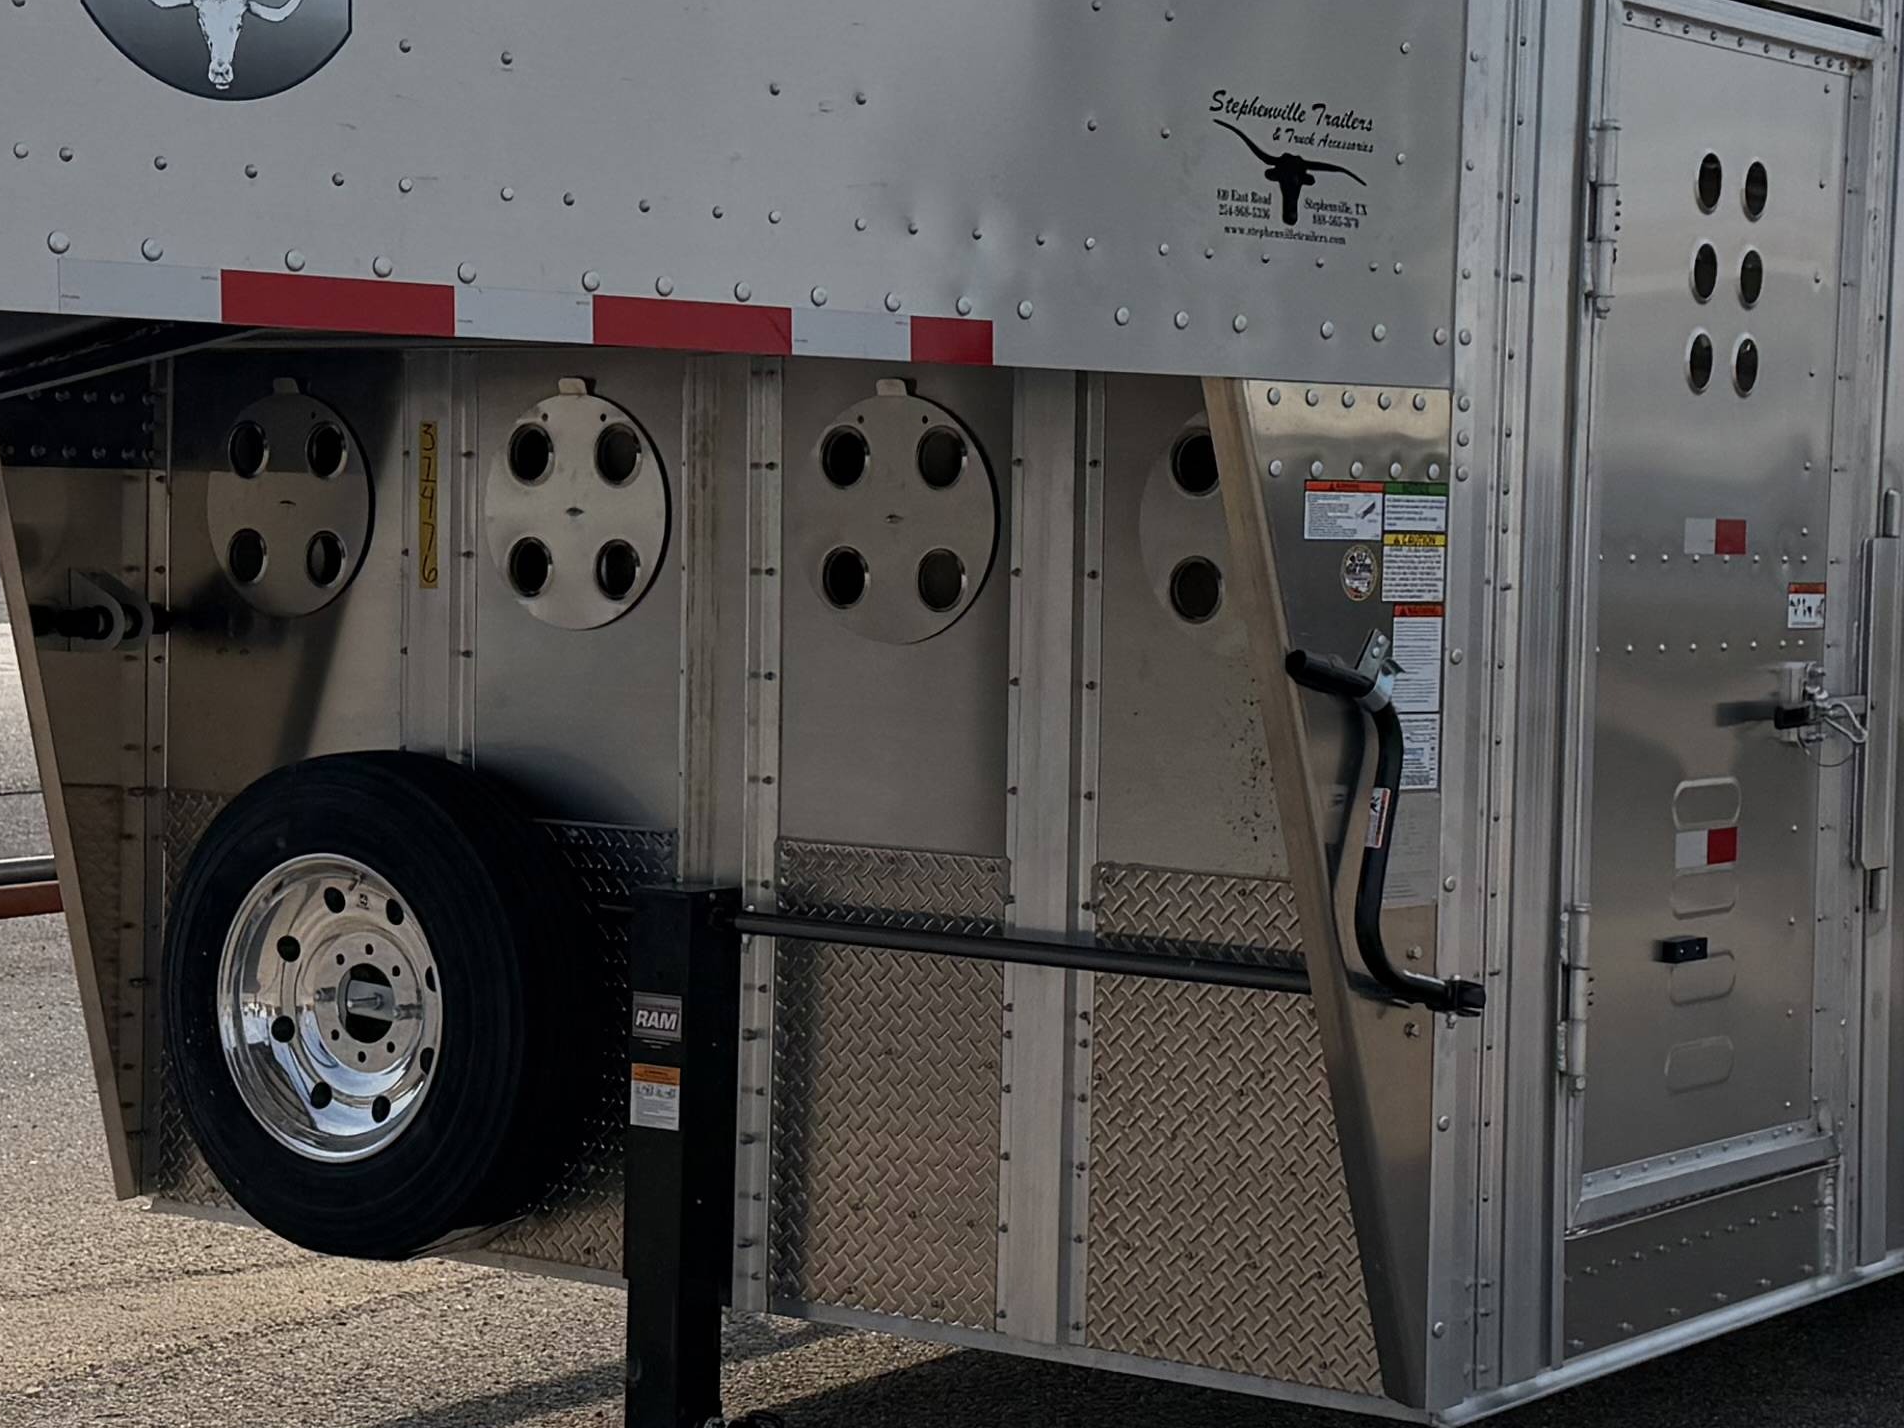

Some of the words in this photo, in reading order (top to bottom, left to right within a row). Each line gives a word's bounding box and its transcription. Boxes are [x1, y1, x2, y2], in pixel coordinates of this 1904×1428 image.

[1209, 89, 1307, 123] Stephenville
[1312, 103, 1374, 132] Trailers
[1272, 127, 1281, 141] &
[1284, 128, 1315, 146] Truck
[1318, 133, 1374, 153] Accessories
[1231, 189, 1249, 203] East
[1251, 192, 1272, 205] Road
[635, 1009, 678, 1031] RAM
